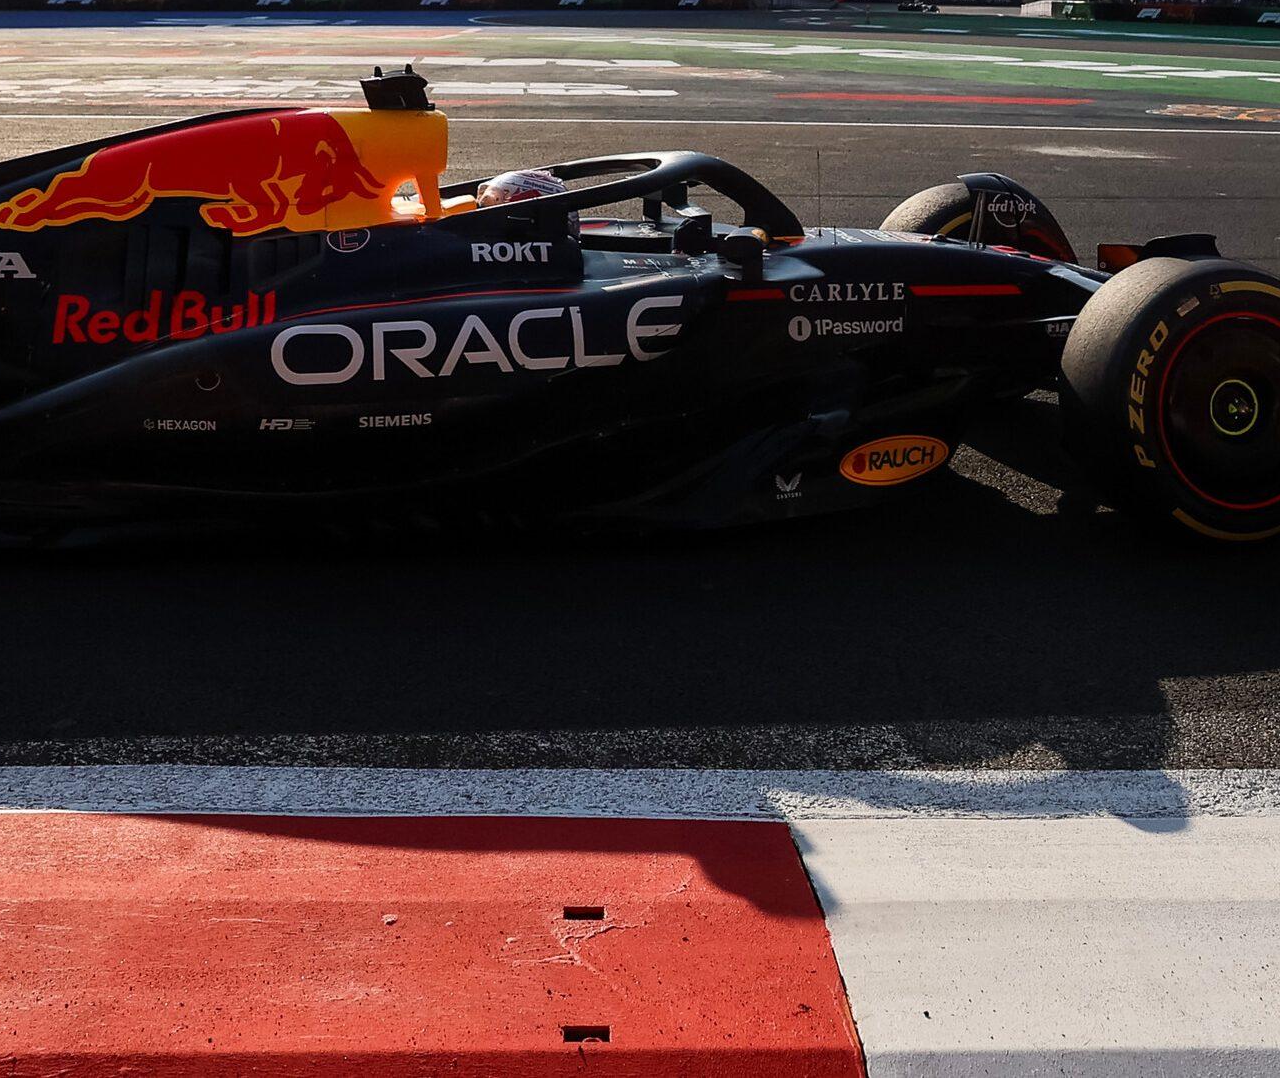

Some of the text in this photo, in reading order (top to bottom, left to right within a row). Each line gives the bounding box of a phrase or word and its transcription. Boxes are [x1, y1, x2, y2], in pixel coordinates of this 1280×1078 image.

[471, 241, 553, 263] ROKT
[789, 282, 905, 302] CARLYLE
[52, 288, 278, 345] Red Bull
[815, 316, 904, 336] 1Password
[271, 295, 685, 386] ORACLE
[1128, 319, 1170, 435] ZERO
[157, 419, 217, 432] HEXAGON
[358, 412, 433, 429] SIEMENS
[869, 446, 935, 471] RAUCH
